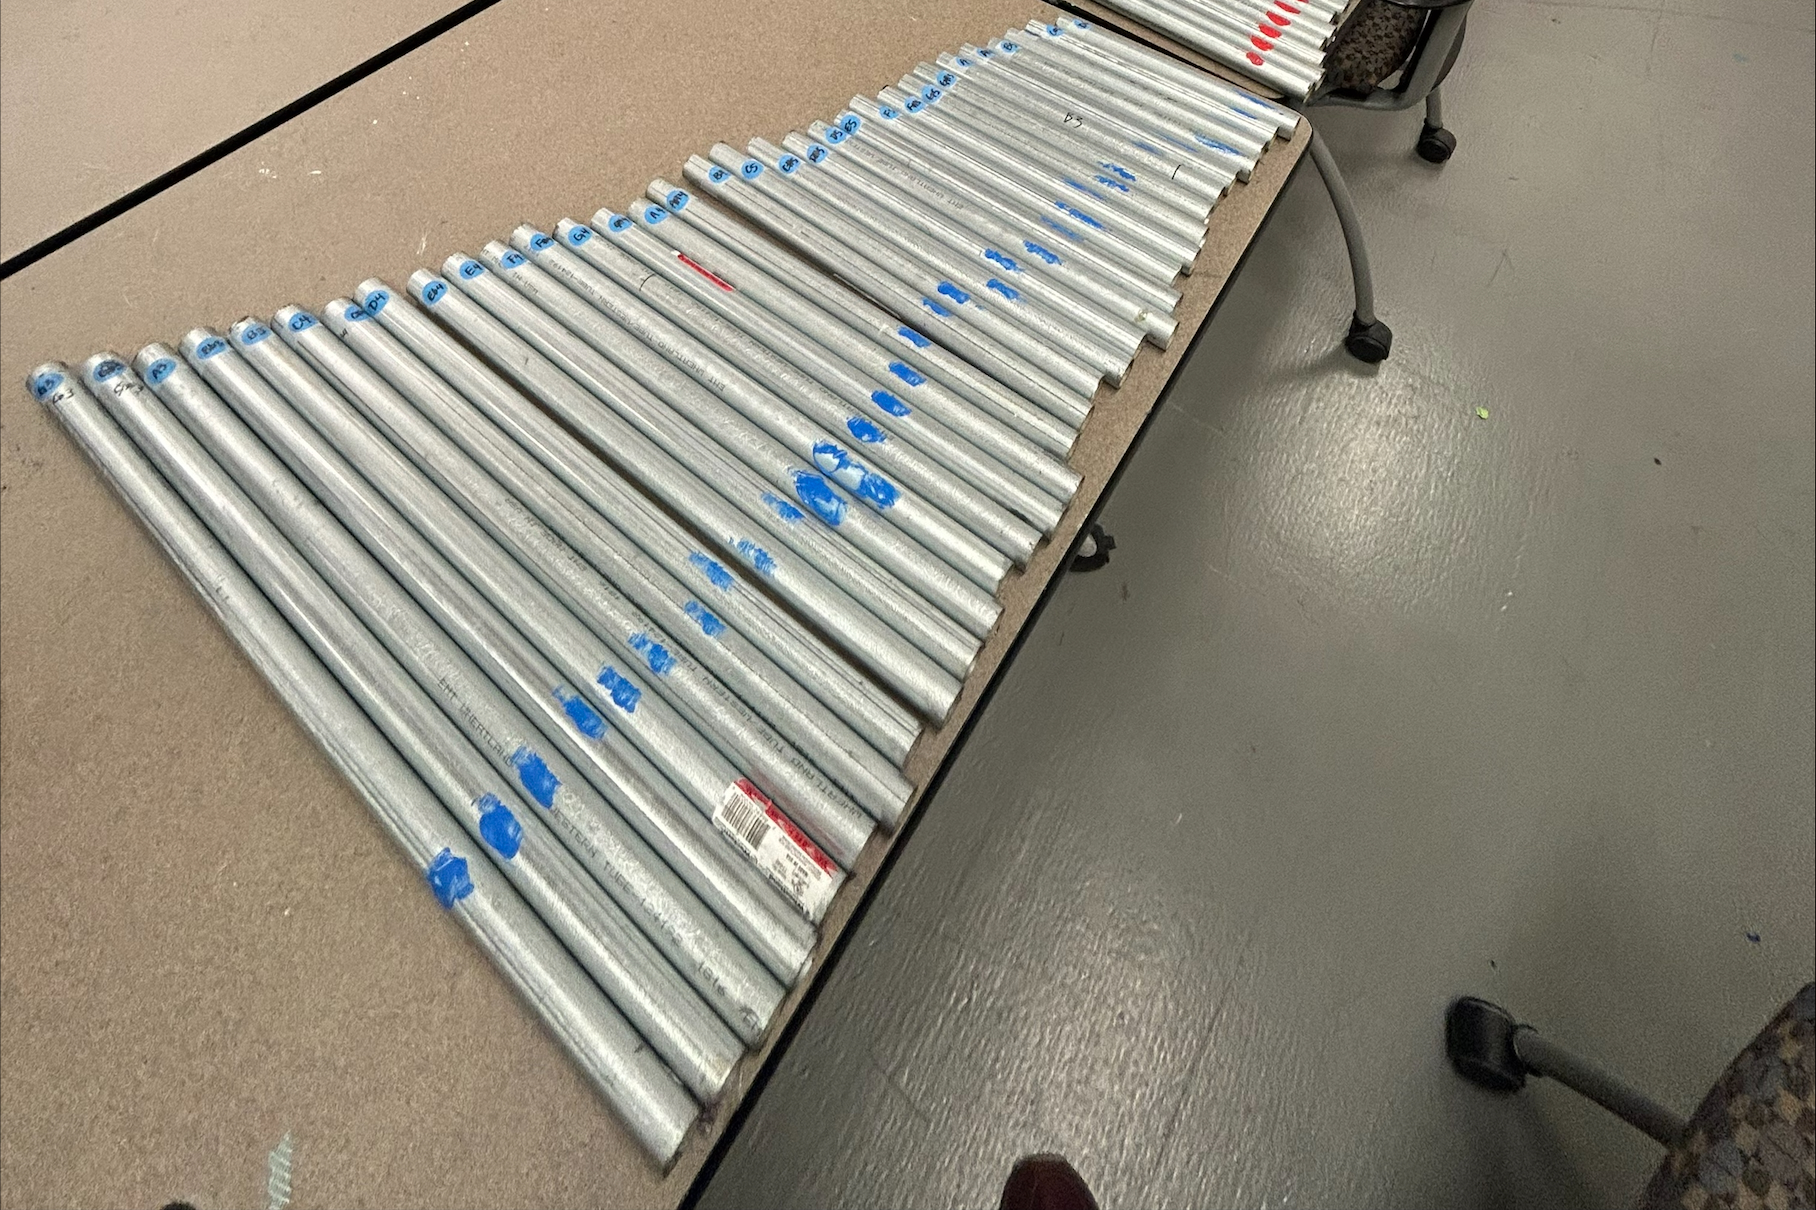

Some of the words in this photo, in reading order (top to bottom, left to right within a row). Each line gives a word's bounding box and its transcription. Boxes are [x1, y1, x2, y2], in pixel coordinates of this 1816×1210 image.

[745, 161, 759, 174] C5
[650, 207, 666, 220] A4
[573, 228, 591, 243] G4
[506, 253, 525, 265] F4
[465, 263, 483, 277] E4
[368, 293, 387, 311] D4
[291, 314, 312, 331] C4
[790, 757, 863, 820] WHEATLAND
